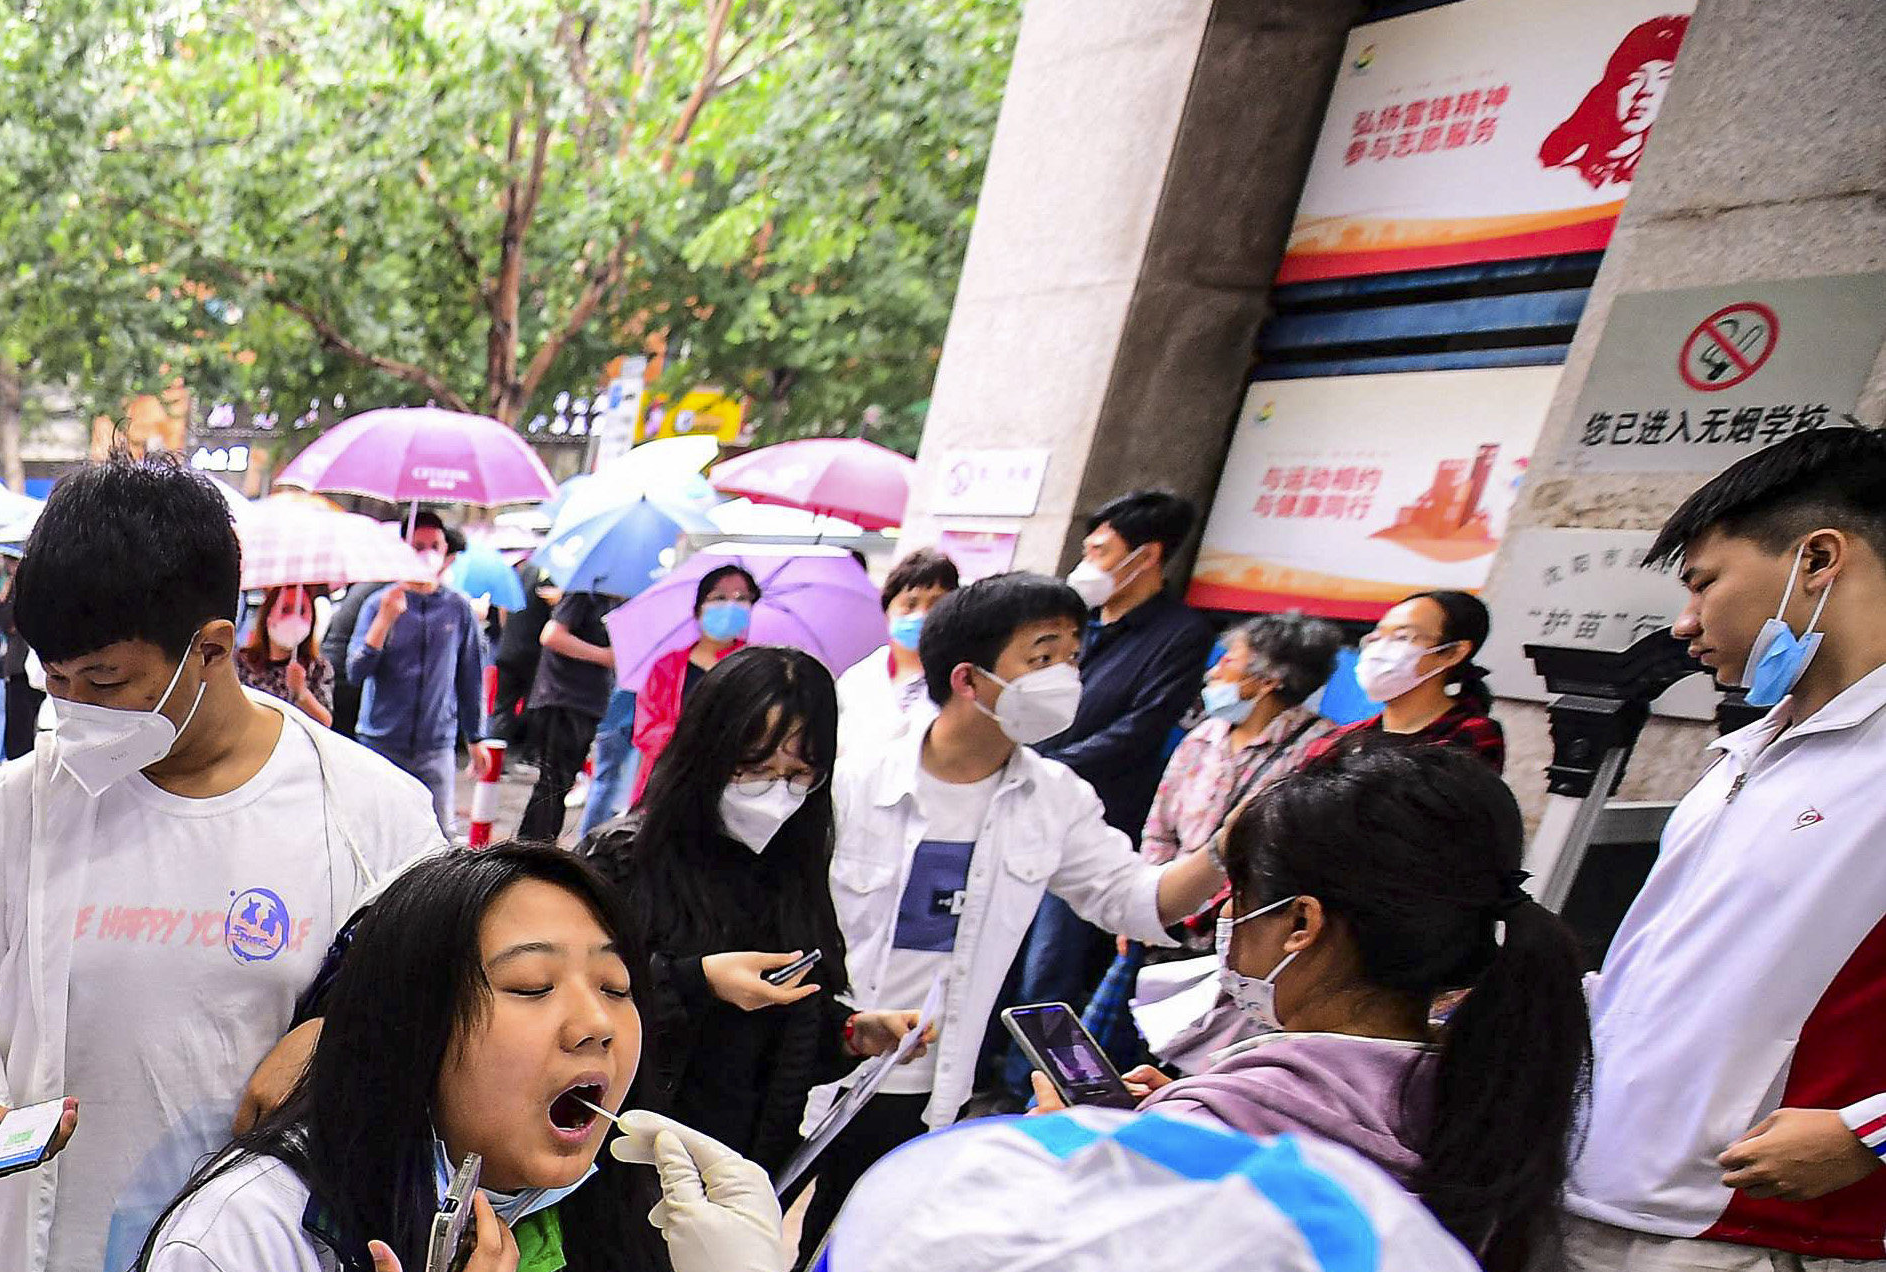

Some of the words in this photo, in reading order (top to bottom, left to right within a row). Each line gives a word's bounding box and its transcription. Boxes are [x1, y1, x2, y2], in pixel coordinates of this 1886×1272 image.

[1352, 82, 1511, 138] 弘扬雷锋精神
[1344, 117, 1499, 167] 参与志愿服务
[1580, 403, 1831, 447] 您已进入无烟学校
